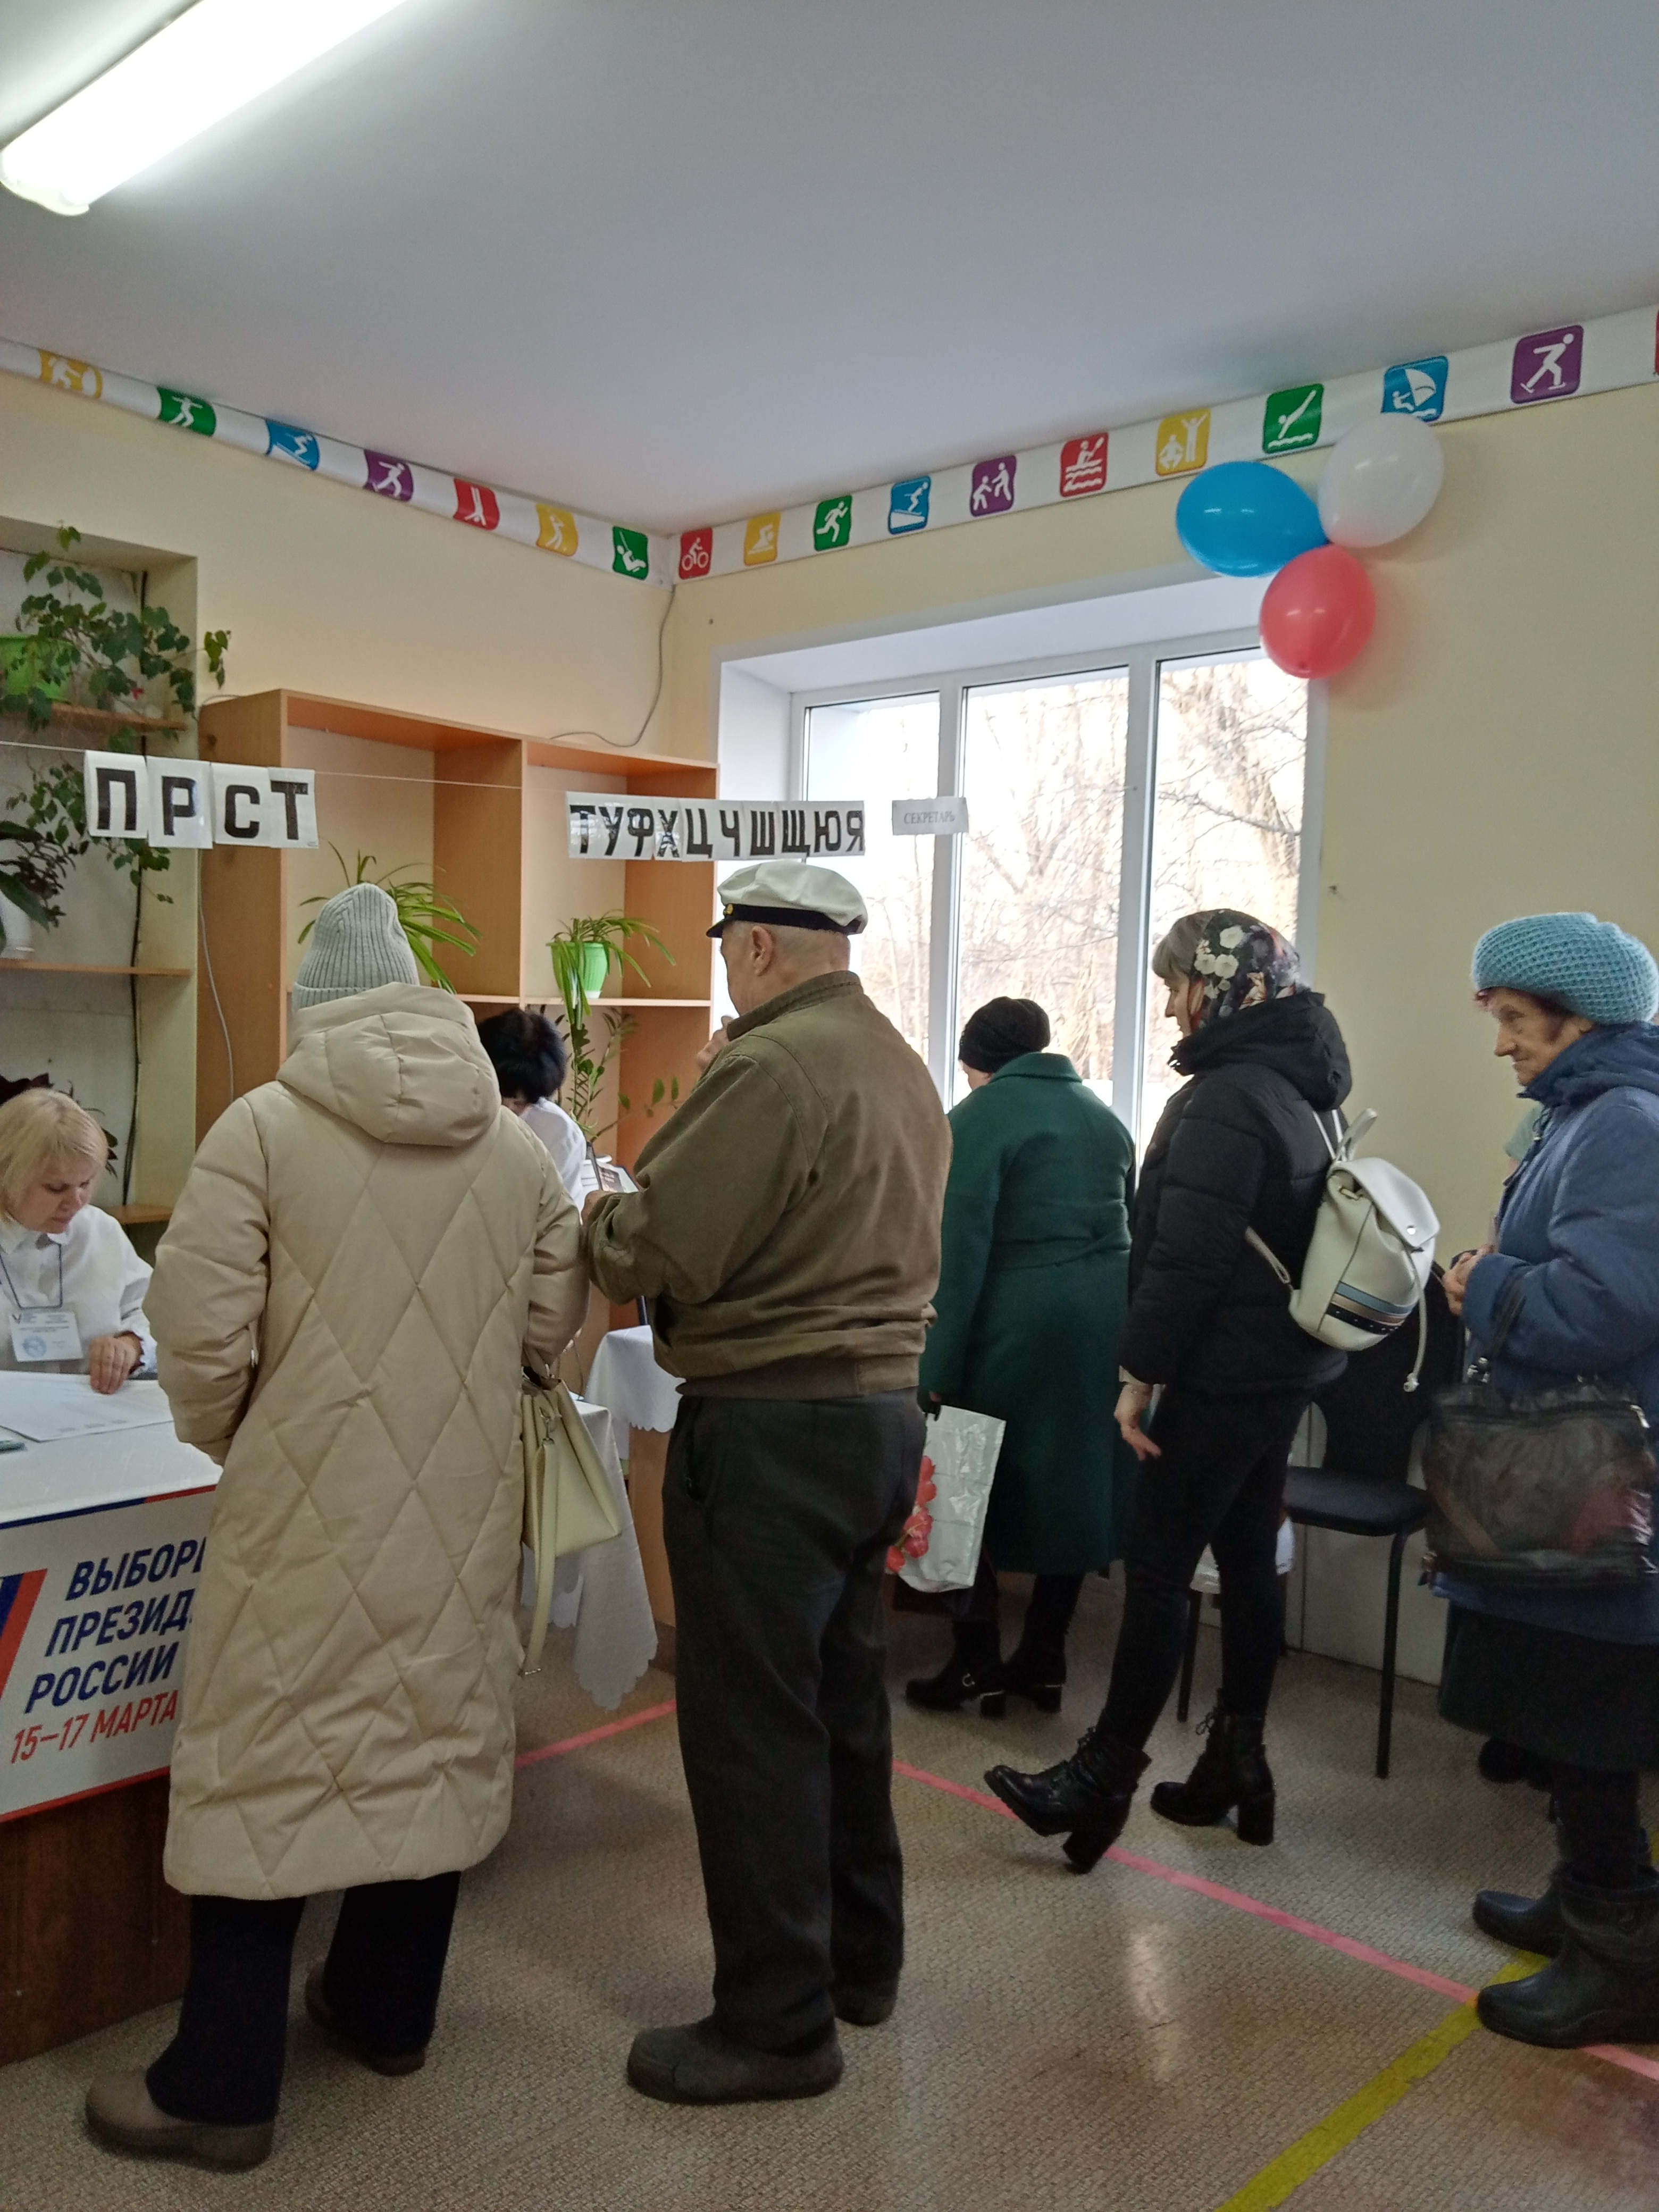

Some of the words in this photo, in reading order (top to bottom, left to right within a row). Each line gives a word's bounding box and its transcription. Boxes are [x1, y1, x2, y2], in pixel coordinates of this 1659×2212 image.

[904, 810, 956, 824] СЕКРЕТАРЬ
[45, 1588, 195, 1656] ПРЕЗИД
[24, 1642, 179, 1714] РОССИИ
[90, 1690, 179, 1743] МАРТА
